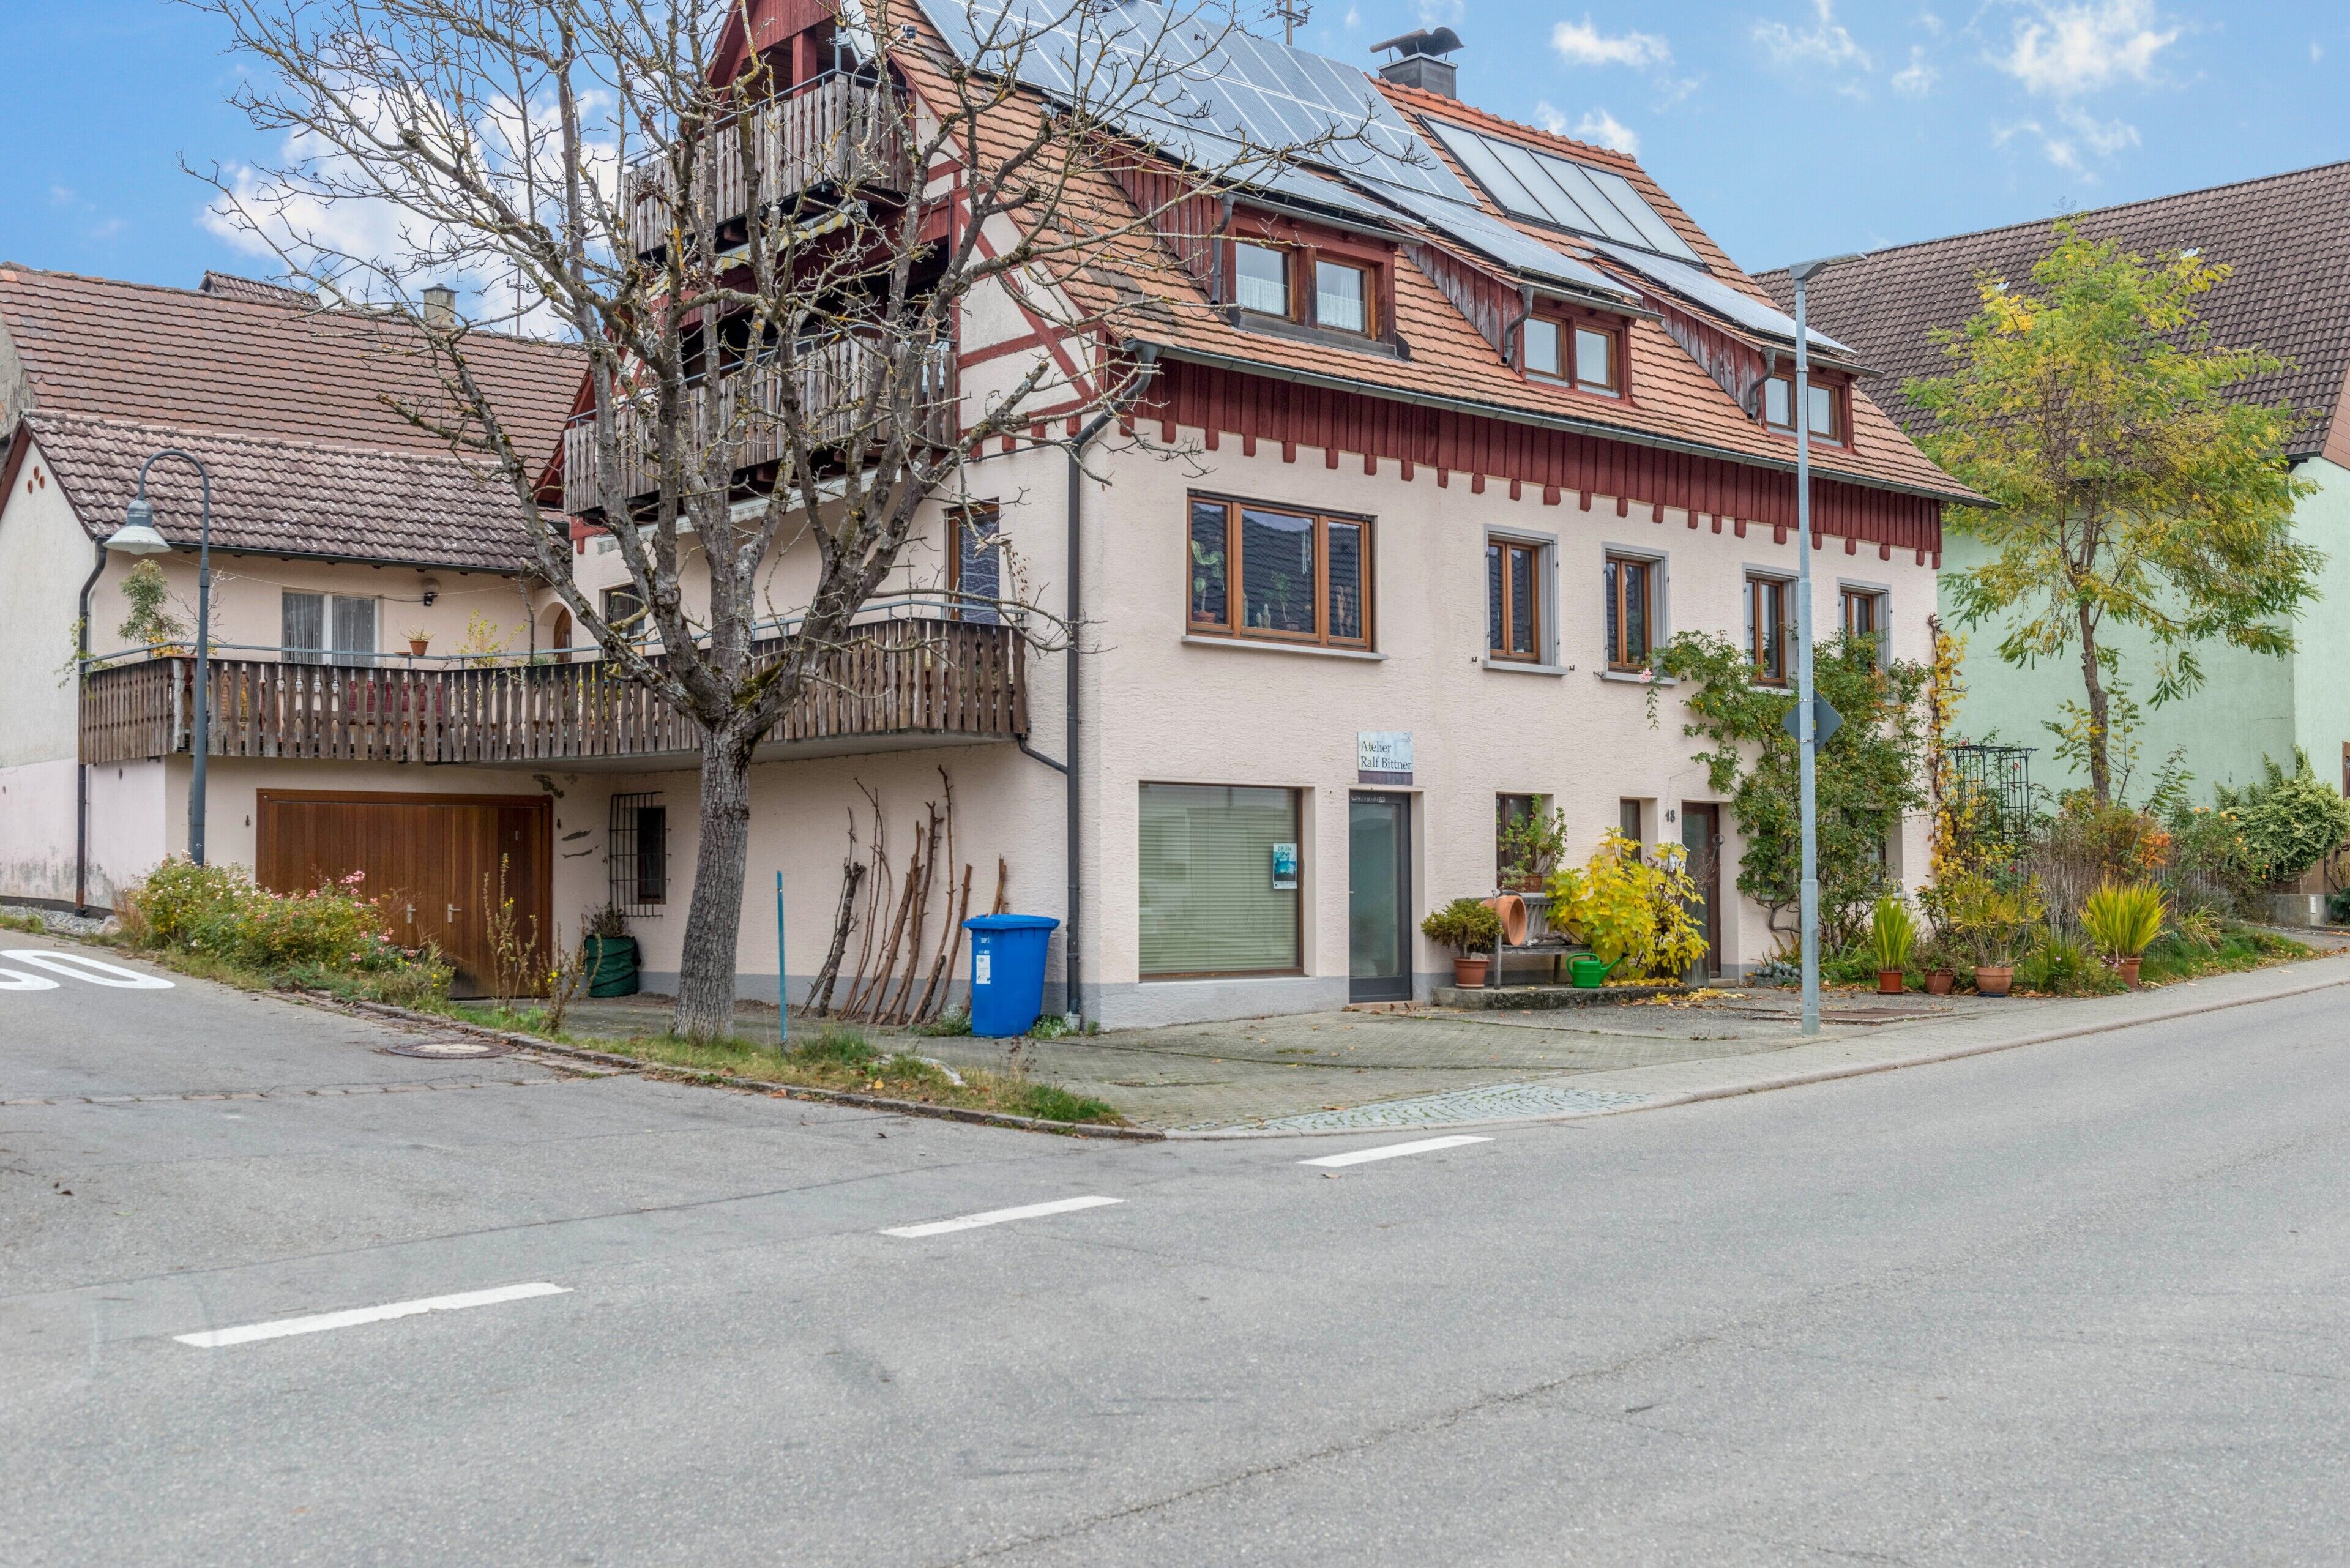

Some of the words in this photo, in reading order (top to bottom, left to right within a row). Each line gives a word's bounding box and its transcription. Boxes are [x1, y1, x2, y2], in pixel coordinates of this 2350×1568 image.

[1360, 741, 1392, 753] Atelier
[1360, 756, 1379, 768] Ralf
[1382, 757, 1412, 770] Bittner
